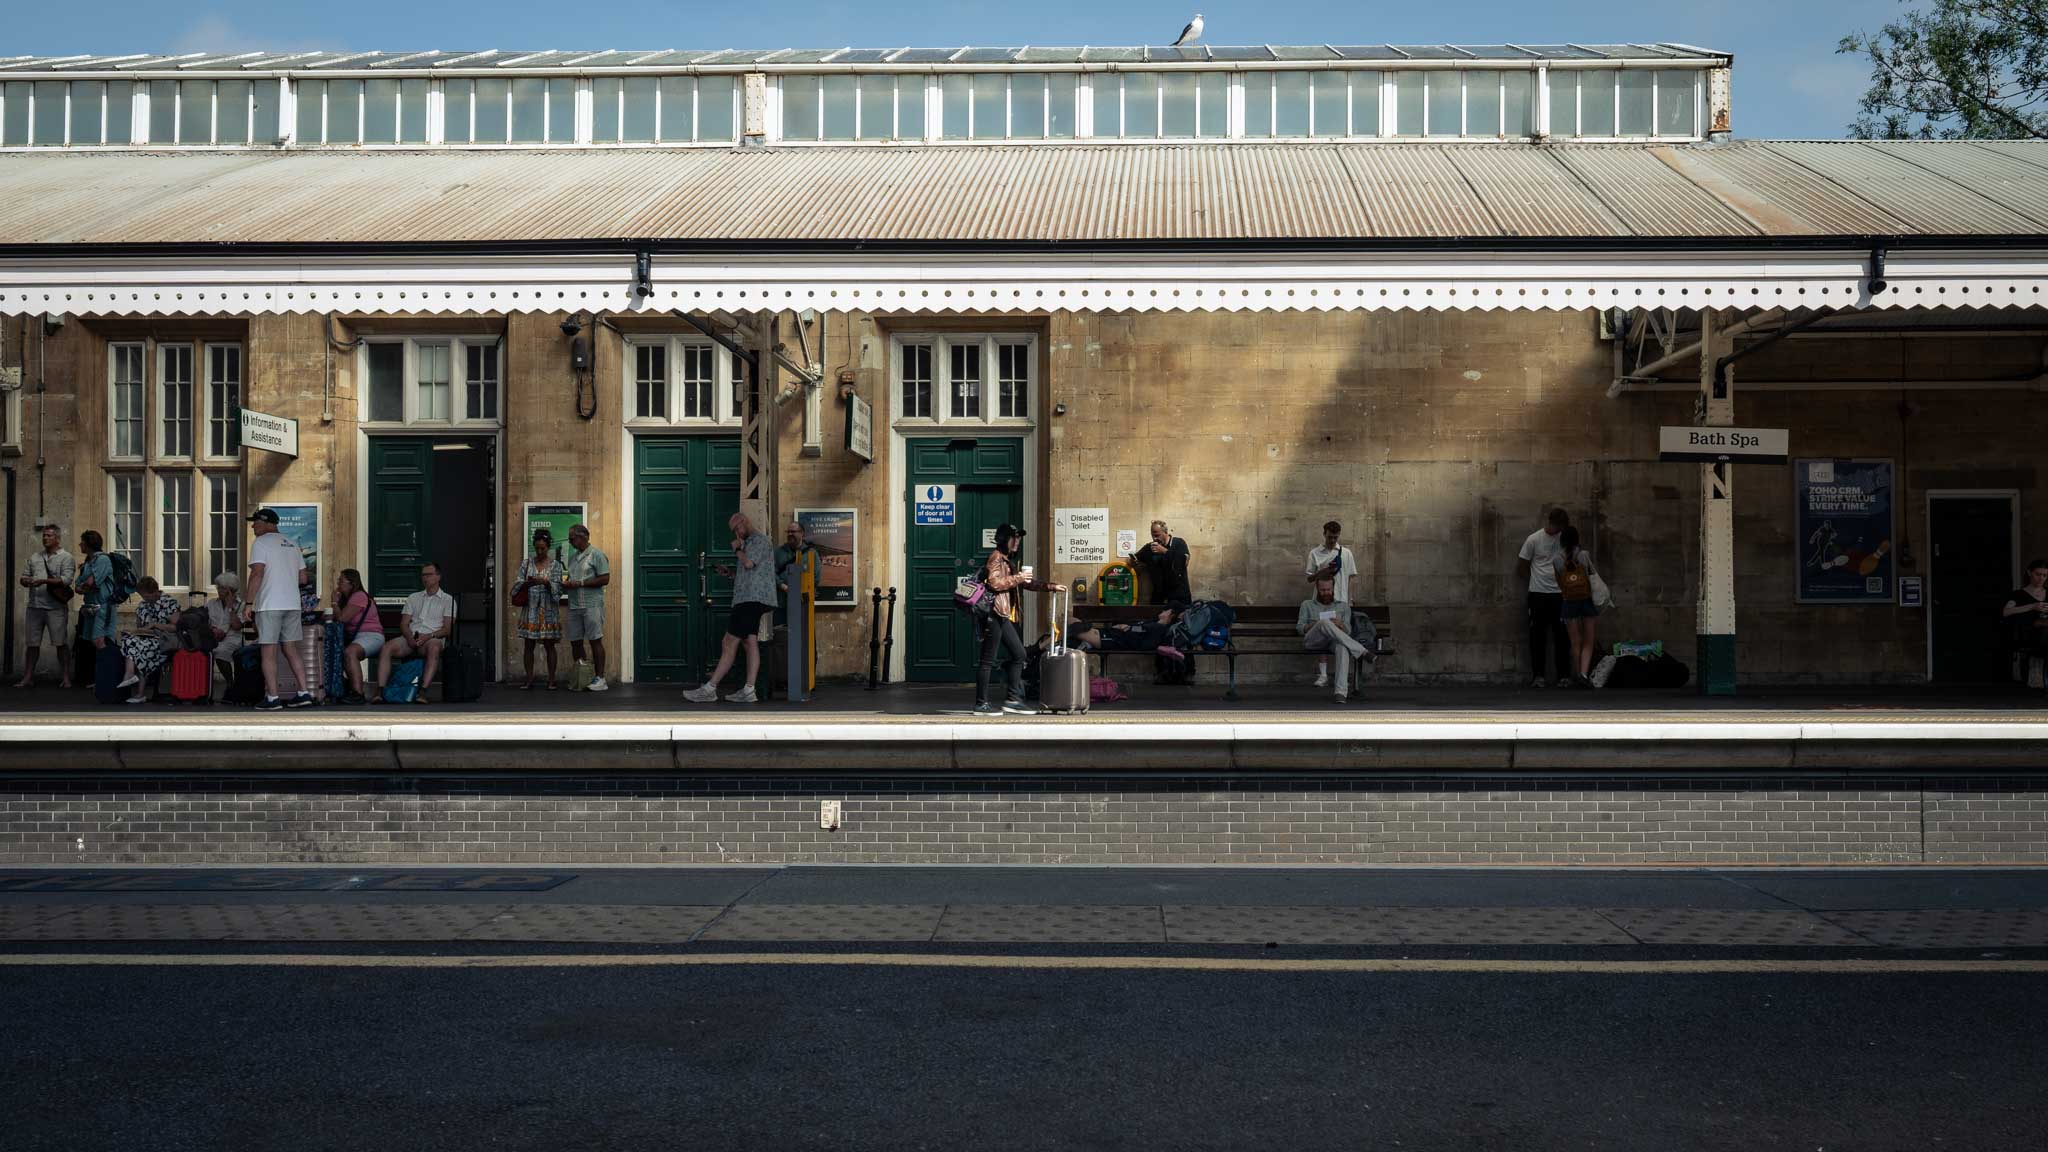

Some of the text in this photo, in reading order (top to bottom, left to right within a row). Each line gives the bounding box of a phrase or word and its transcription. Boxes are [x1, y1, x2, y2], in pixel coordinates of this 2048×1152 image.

[250, 415, 288, 433] Information &
[251, 430, 282, 446] Assistance
[1689, 432, 1759, 448] Bath Spa
[1808, 486, 1837, 495] ZOHO
[1809, 503, 1840, 511] EVERY
[1070, 538, 1088, 546] Baby
[1070, 546, 1105, 554] Changing
